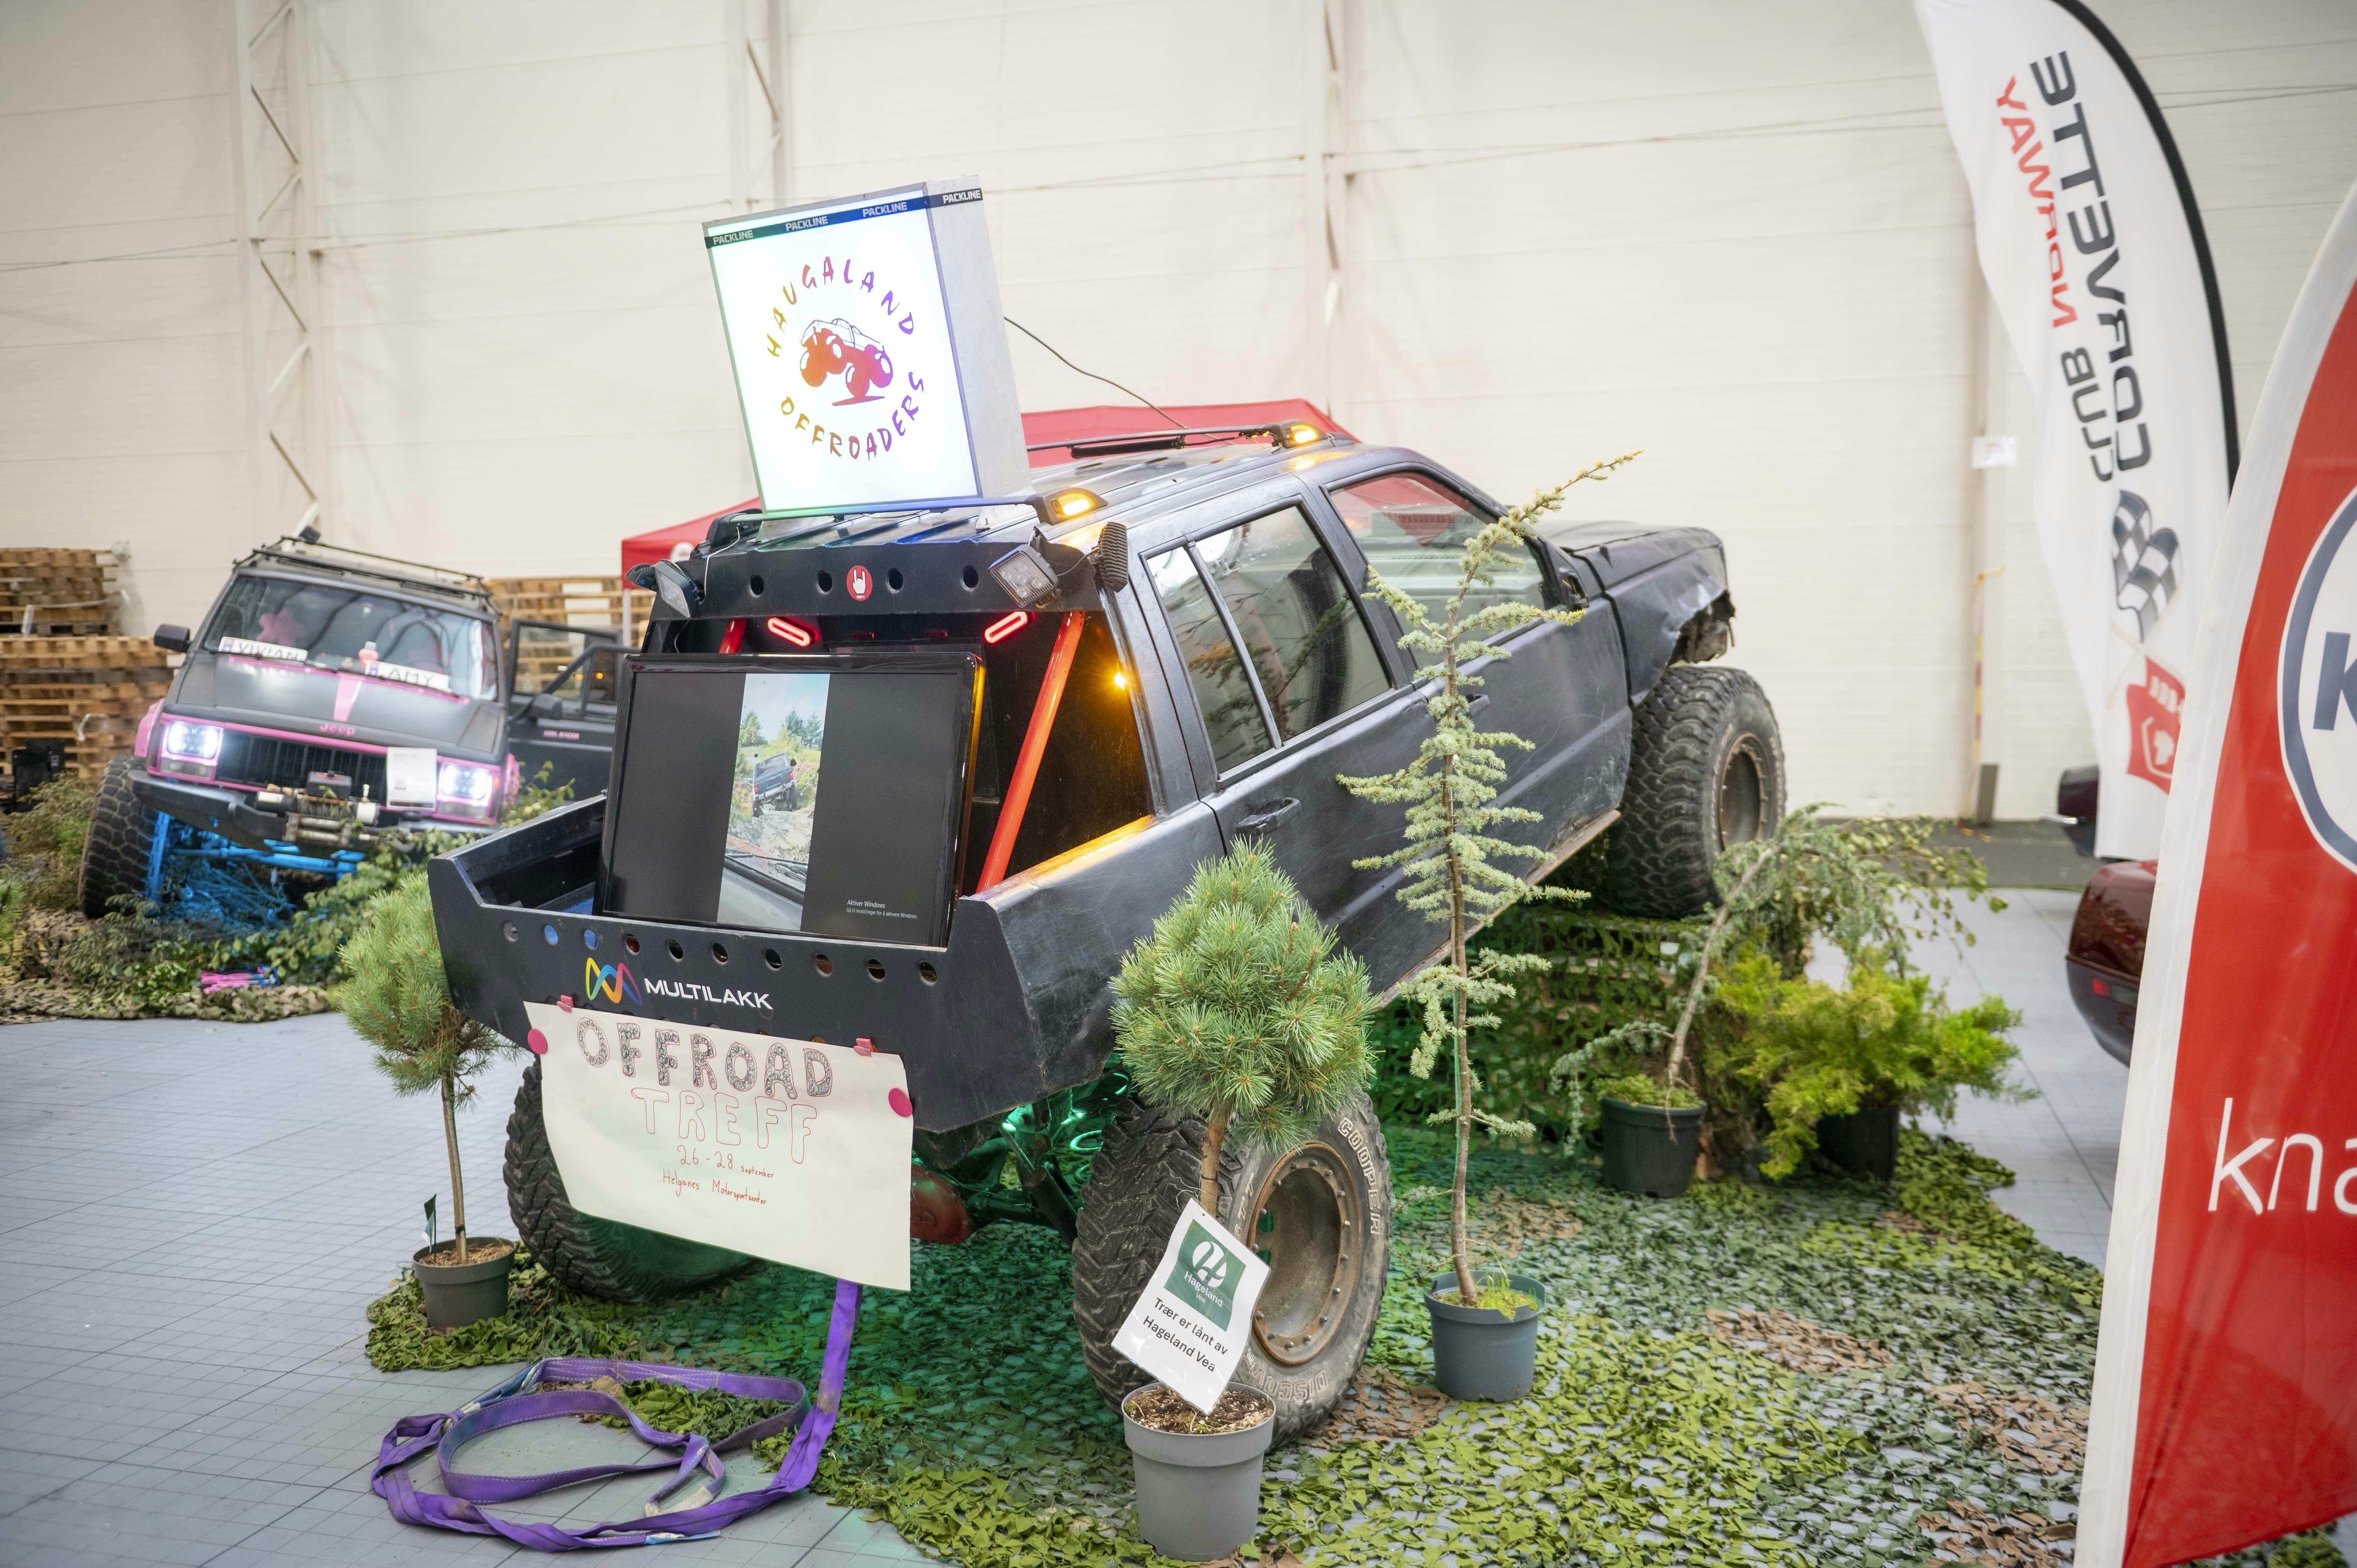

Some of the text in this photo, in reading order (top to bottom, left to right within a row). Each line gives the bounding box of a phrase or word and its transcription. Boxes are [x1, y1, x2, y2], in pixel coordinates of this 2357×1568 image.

[713, 189, 982, 245] PACKLINE PACKLINE PACKLINE PACKLINE
[767, 256, 914, 357] HAUGALAND
[781, 371, 924, 461] OFFROADERS
[239, 642, 299, 660] VIVIAN
[389, 667, 436, 687] AMY
[320, 723, 355, 737] Jeep
[644, 977, 773, 1010] MULTILAKK
[577, 1017, 832, 1099] OFFROAD
[631, 1088, 817, 1164] TREFF
[677, 1145, 699, 1165] 26
[715, 1151, 733, 1169] 28
[1338, 1117, 1380, 1234] COOPER
[663, 1169, 767, 1204] Helganes Motorsportsenter
[1184, 1270, 1223, 1307] Hageland
[1196, 1292, 1206, 1303] Vea
[1143, 1315, 1215, 1372] Hageland Vea
[1154, 1297, 1228, 1354] Trær er lånt av
[1244, 1347, 1328, 1400] DISCOVE
